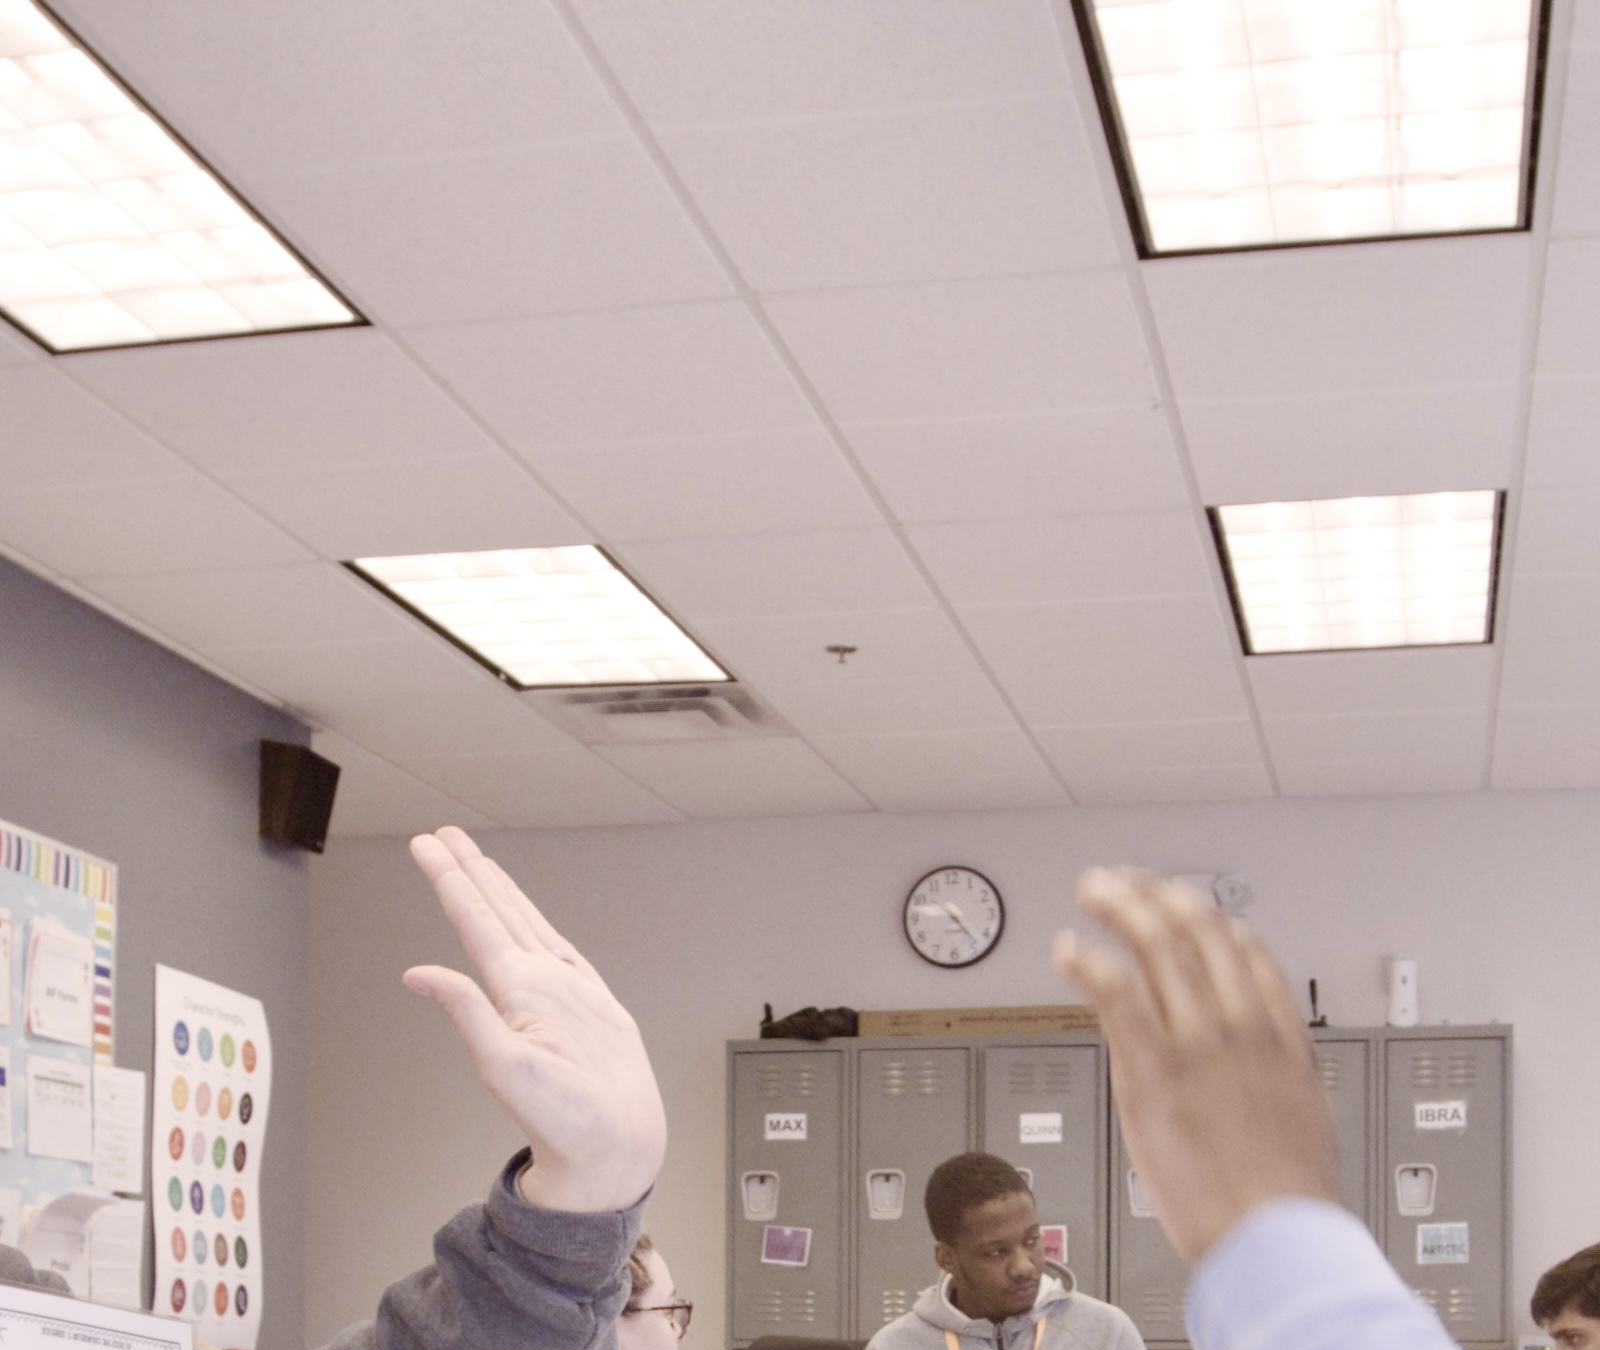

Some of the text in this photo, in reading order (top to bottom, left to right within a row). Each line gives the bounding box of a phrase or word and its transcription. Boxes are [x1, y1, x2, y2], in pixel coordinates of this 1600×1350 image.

[945, 871, 960, 885] 12
[929, 879, 939, 892] 11
[914, 893, 927, 906] 10
[981, 889, 988, 902] 2
[911, 913, 919, 926] 9
[988, 907, 995, 920] 3
[917, 930, 926, 943] 8
[983, 927, 990, 939] 4
[932, 944, 940, 957] 7
[950, 947, 959, 960] 6
[1420, 1107, 1463, 1123] IBRA
[769, 1119, 805, 1132] MAX
[1022, 1125, 1061, 1136] QUINN
